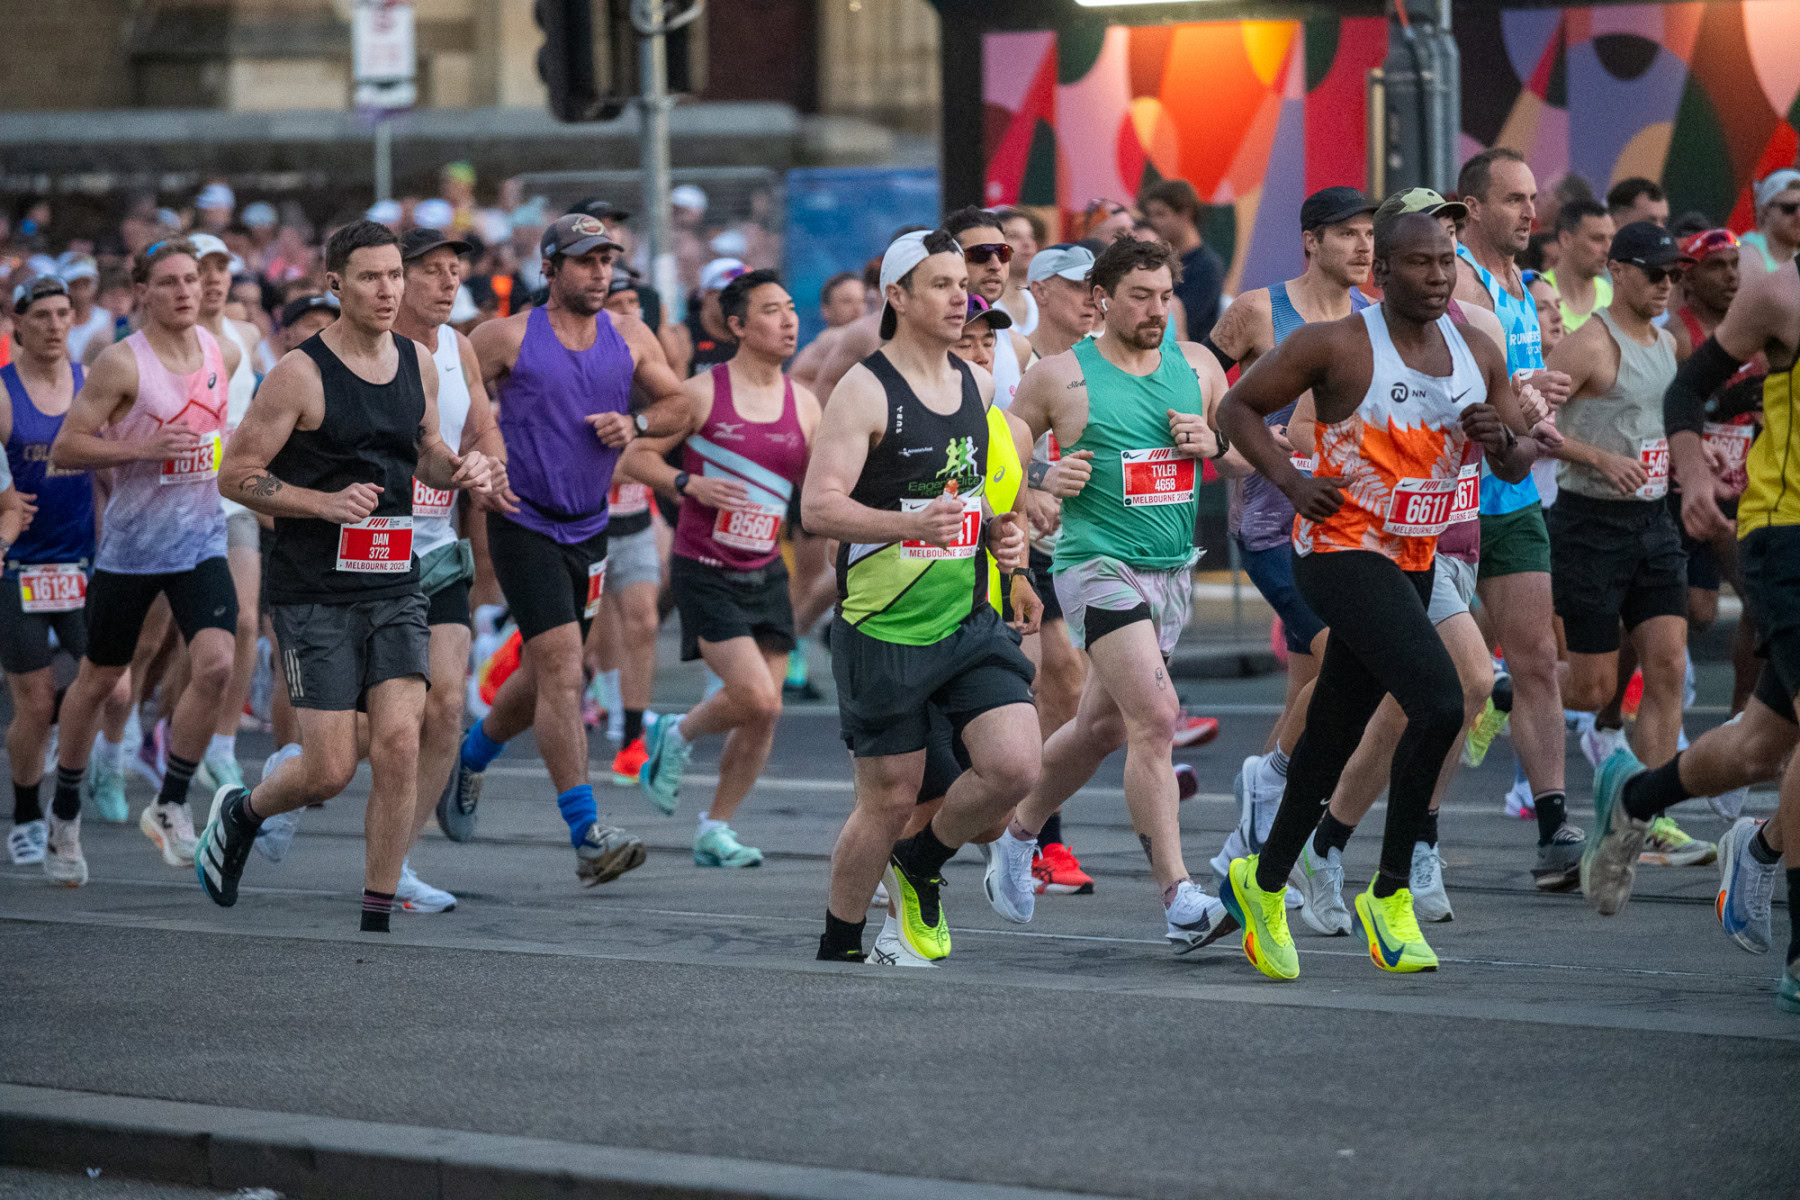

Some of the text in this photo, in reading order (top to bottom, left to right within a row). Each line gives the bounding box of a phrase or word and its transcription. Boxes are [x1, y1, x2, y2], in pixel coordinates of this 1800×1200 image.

[1412, 390, 1426, 398] NN
[1152, 464, 1177, 478] TYLER
[1154, 478, 1176, 491] 4658
[1132, 494, 1176, 505] MELBOURNE
[1406, 494, 1449, 524] 6611
[729, 511, 775, 539] 8560
[1392, 525, 1433, 535] MELBOURNE
[372, 533, 390, 546] DAN
[368, 546, 390, 560] 3722
[908, 548, 957, 558] MELBOURNE
[345, 561, 406, 571] MELBOURNE 2025
[31, 575, 80, 601] 16134
